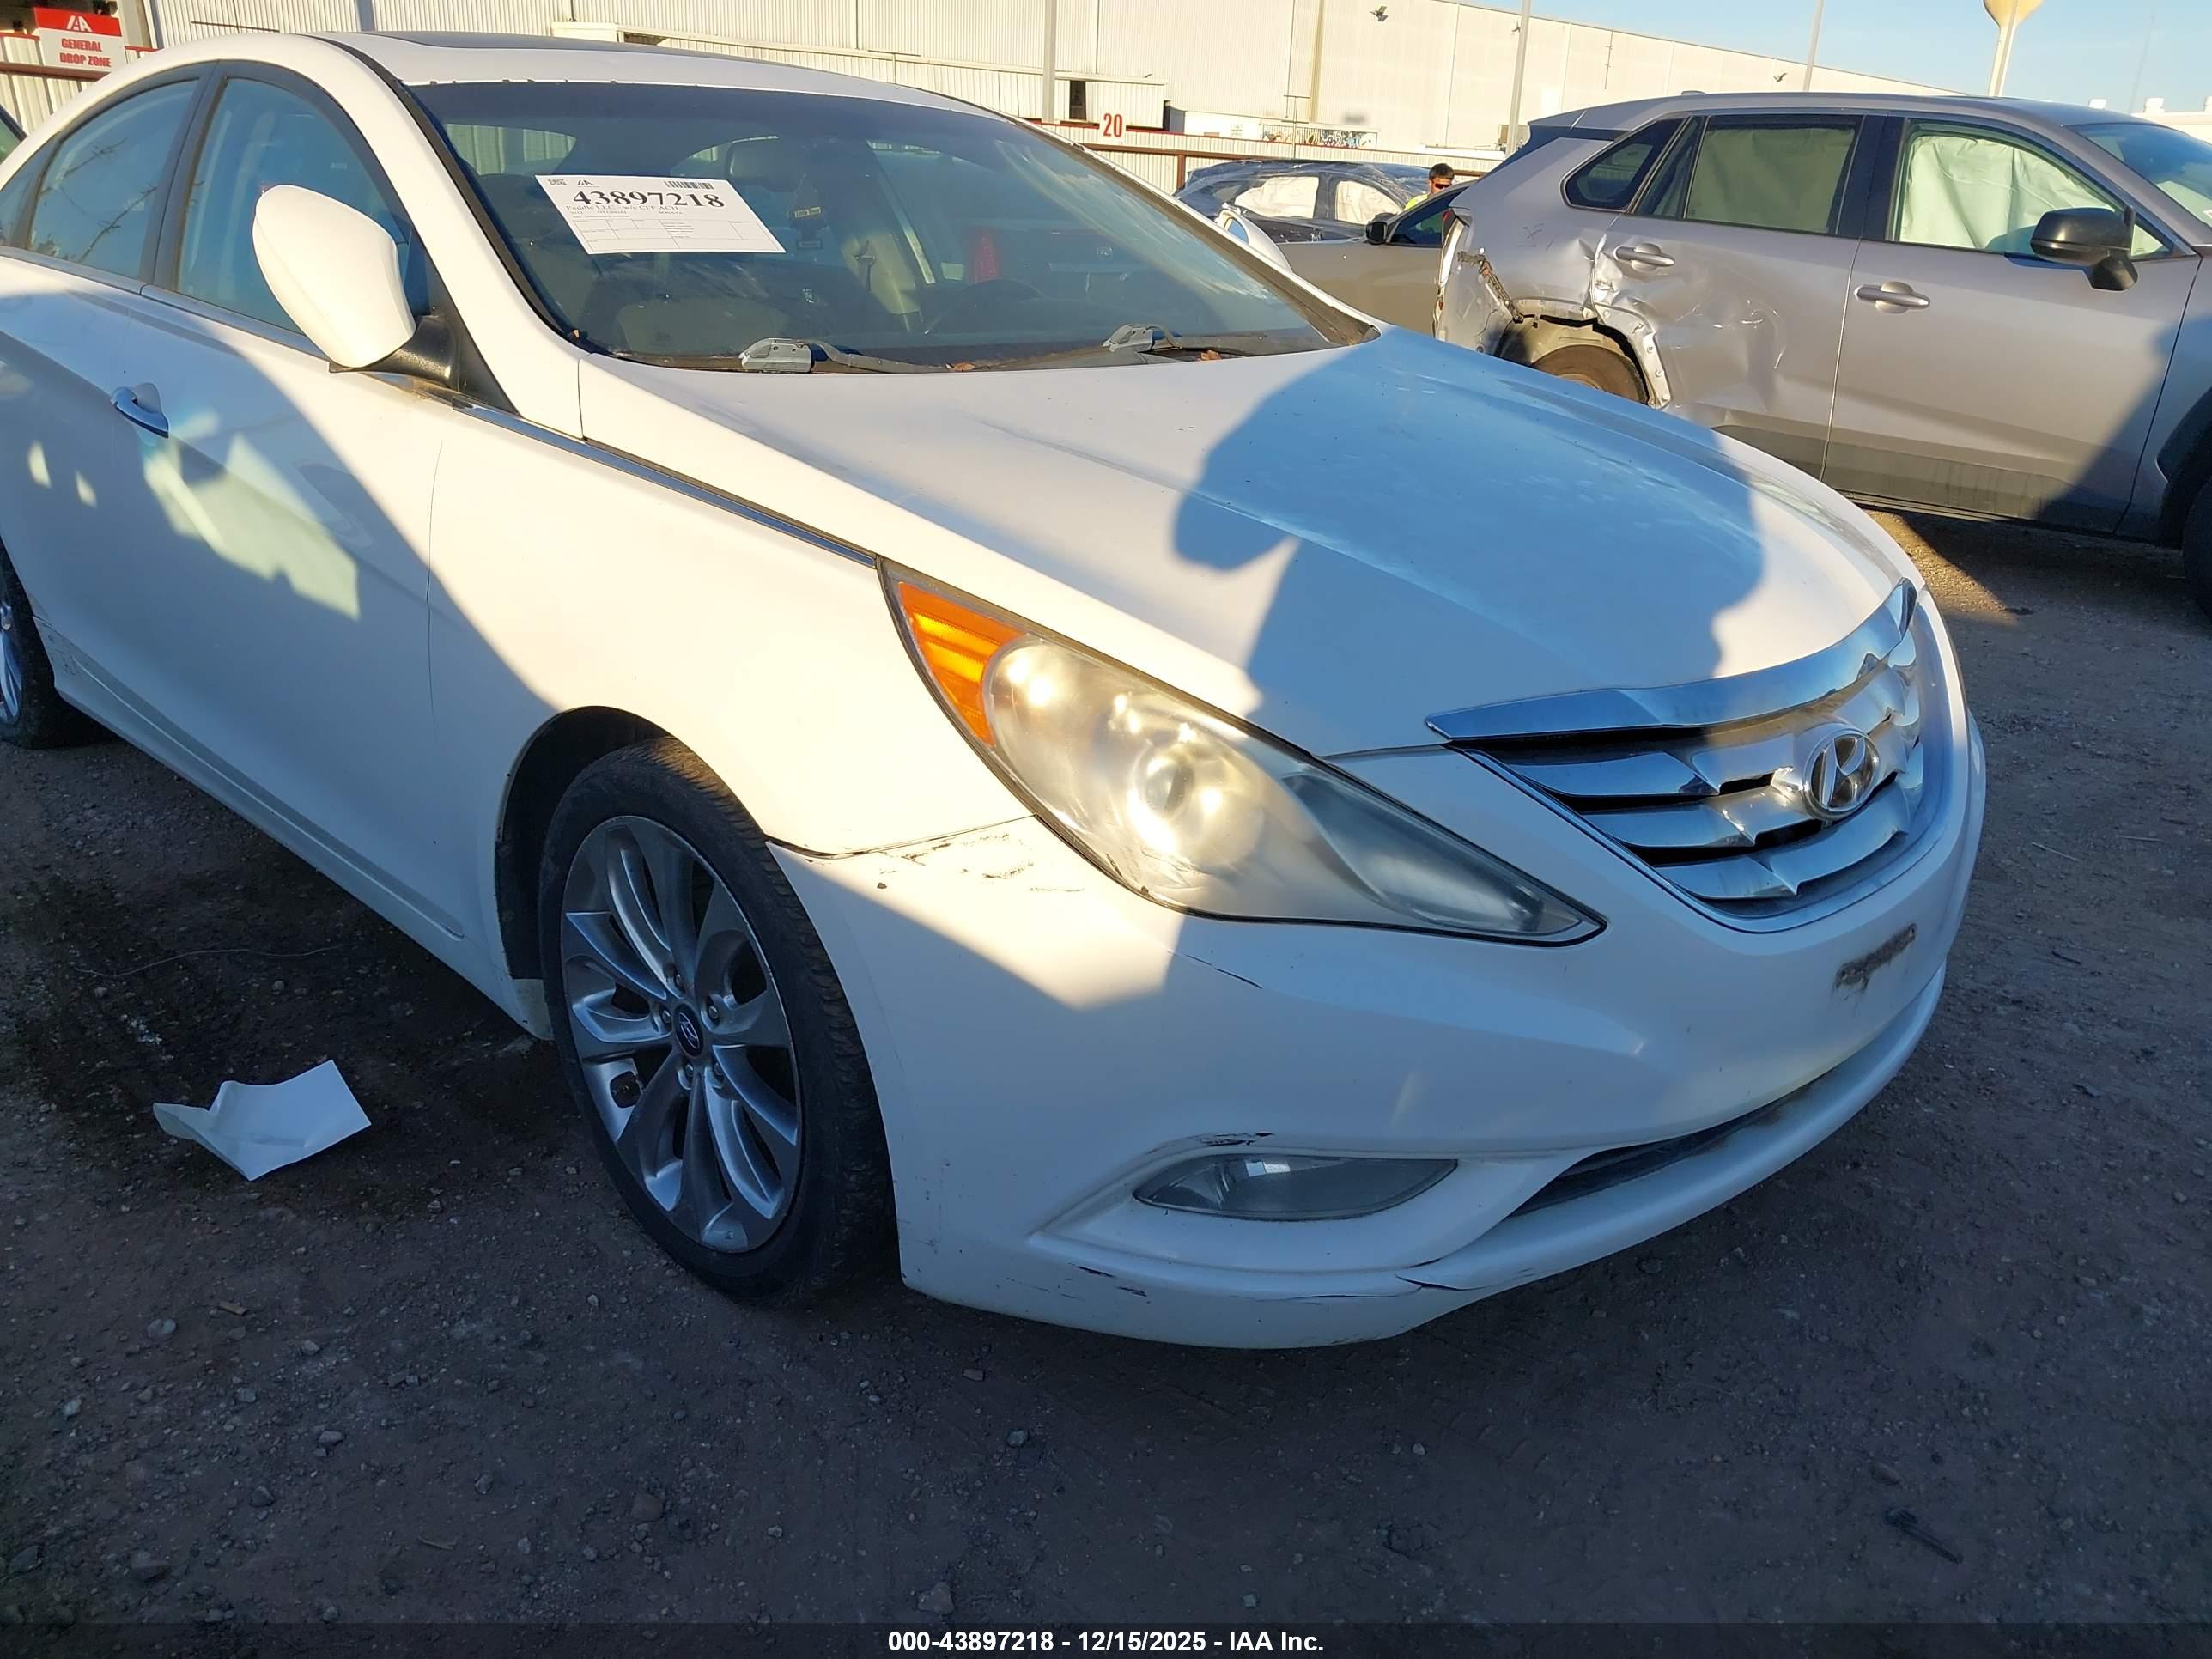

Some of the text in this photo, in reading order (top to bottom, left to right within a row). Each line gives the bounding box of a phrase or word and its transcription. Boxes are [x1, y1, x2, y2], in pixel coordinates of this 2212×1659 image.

[61, 38, 103, 52] GENERAL
[59, 52, 112, 67] DROP ZONE
[1103, 112, 1123, 137] 20
[573, 191, 725, 207] 43897218
